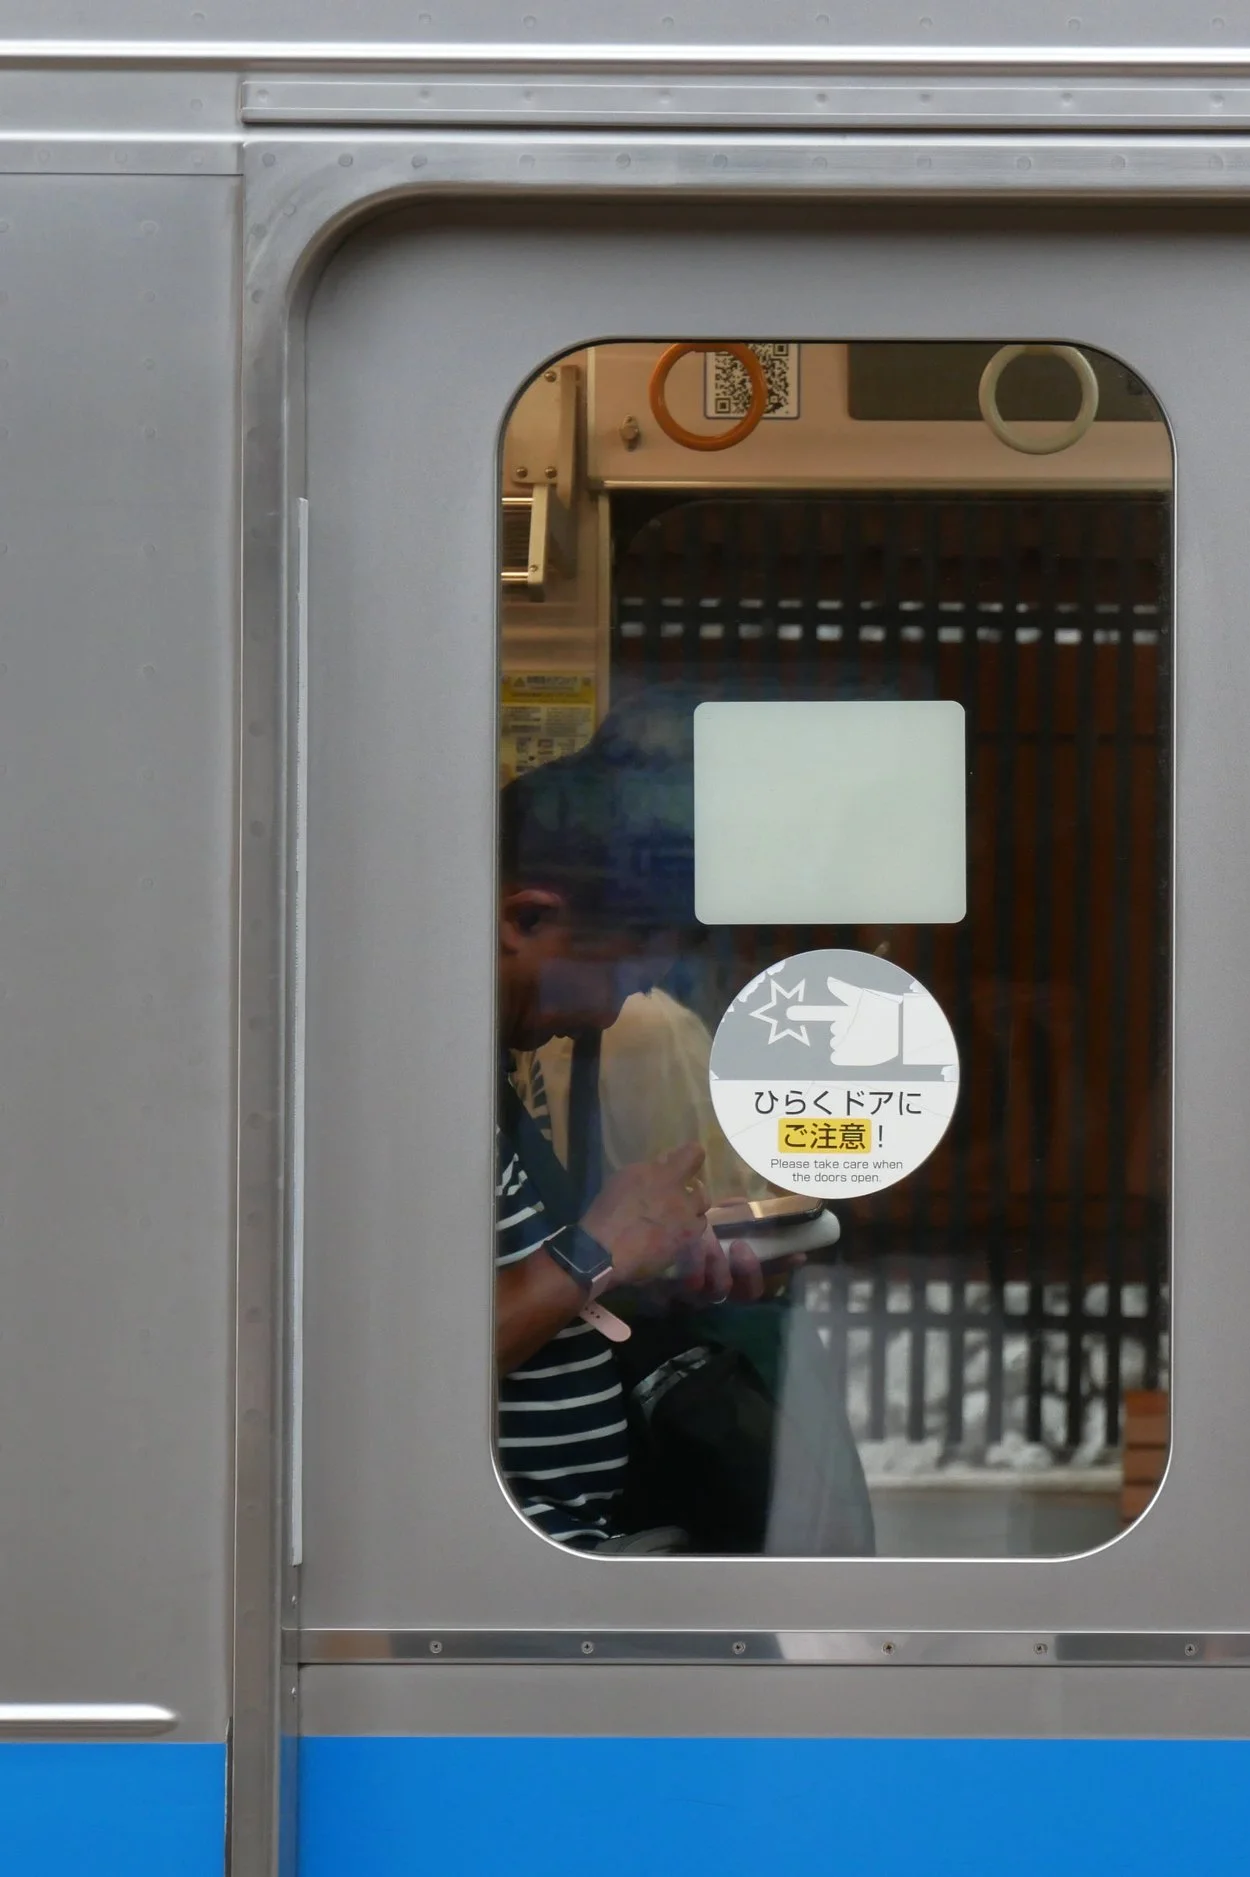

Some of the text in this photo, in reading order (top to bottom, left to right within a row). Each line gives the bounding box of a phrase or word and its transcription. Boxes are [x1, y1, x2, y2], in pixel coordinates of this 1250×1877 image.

[754, 1090, 922, 1116] ひらくドアに
[770, 1158, 903, 1170] Please take care when
[792, 1172, 882, 1184] the doors open.
